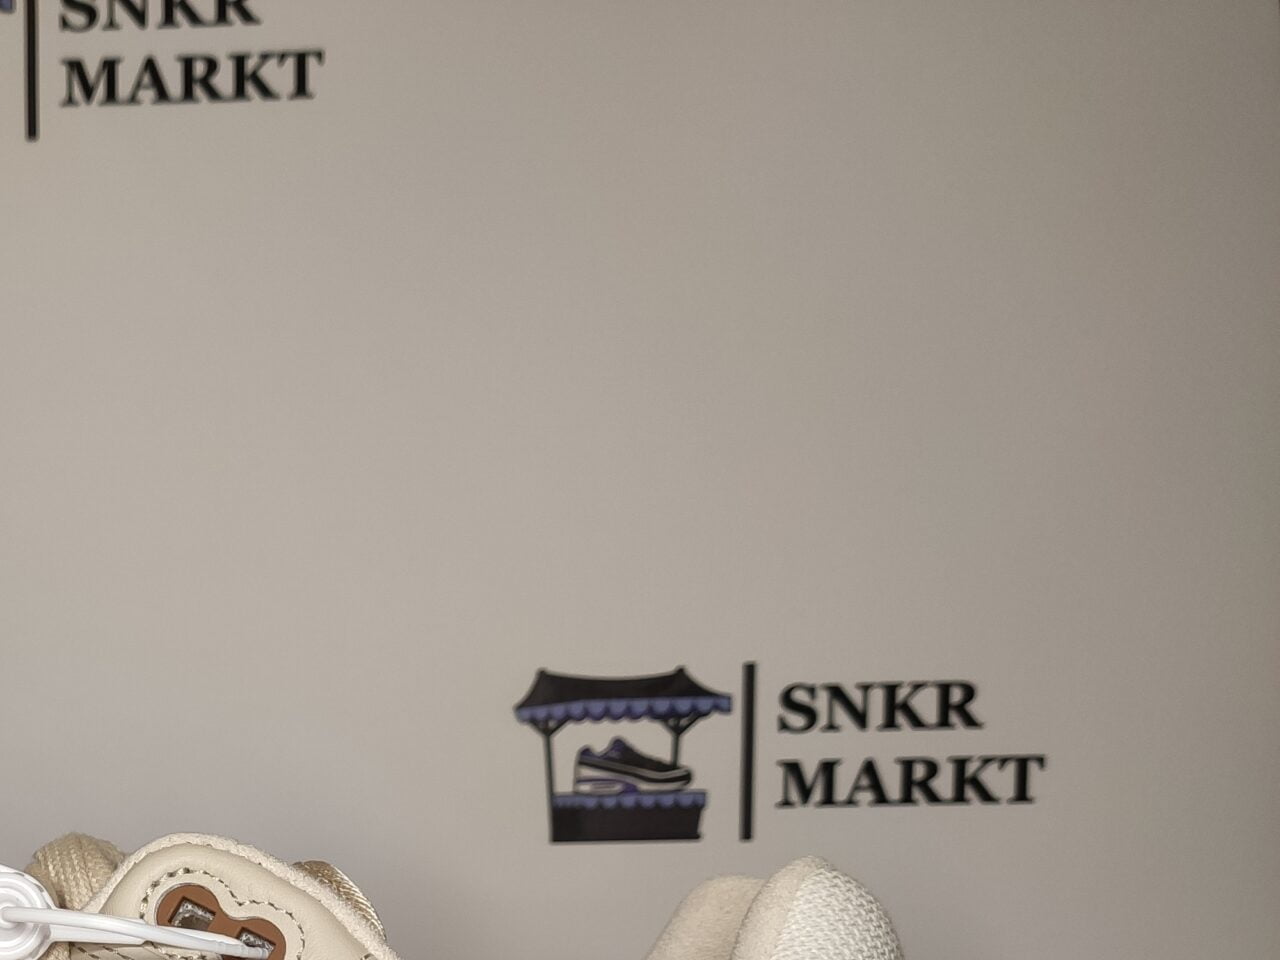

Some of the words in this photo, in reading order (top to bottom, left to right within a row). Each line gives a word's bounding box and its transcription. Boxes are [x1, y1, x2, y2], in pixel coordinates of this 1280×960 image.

[59, 49, 325, 107] MARKT
[777, 680, 985, 732] SNKR
[776, 754, 1045, 808] MARKT
